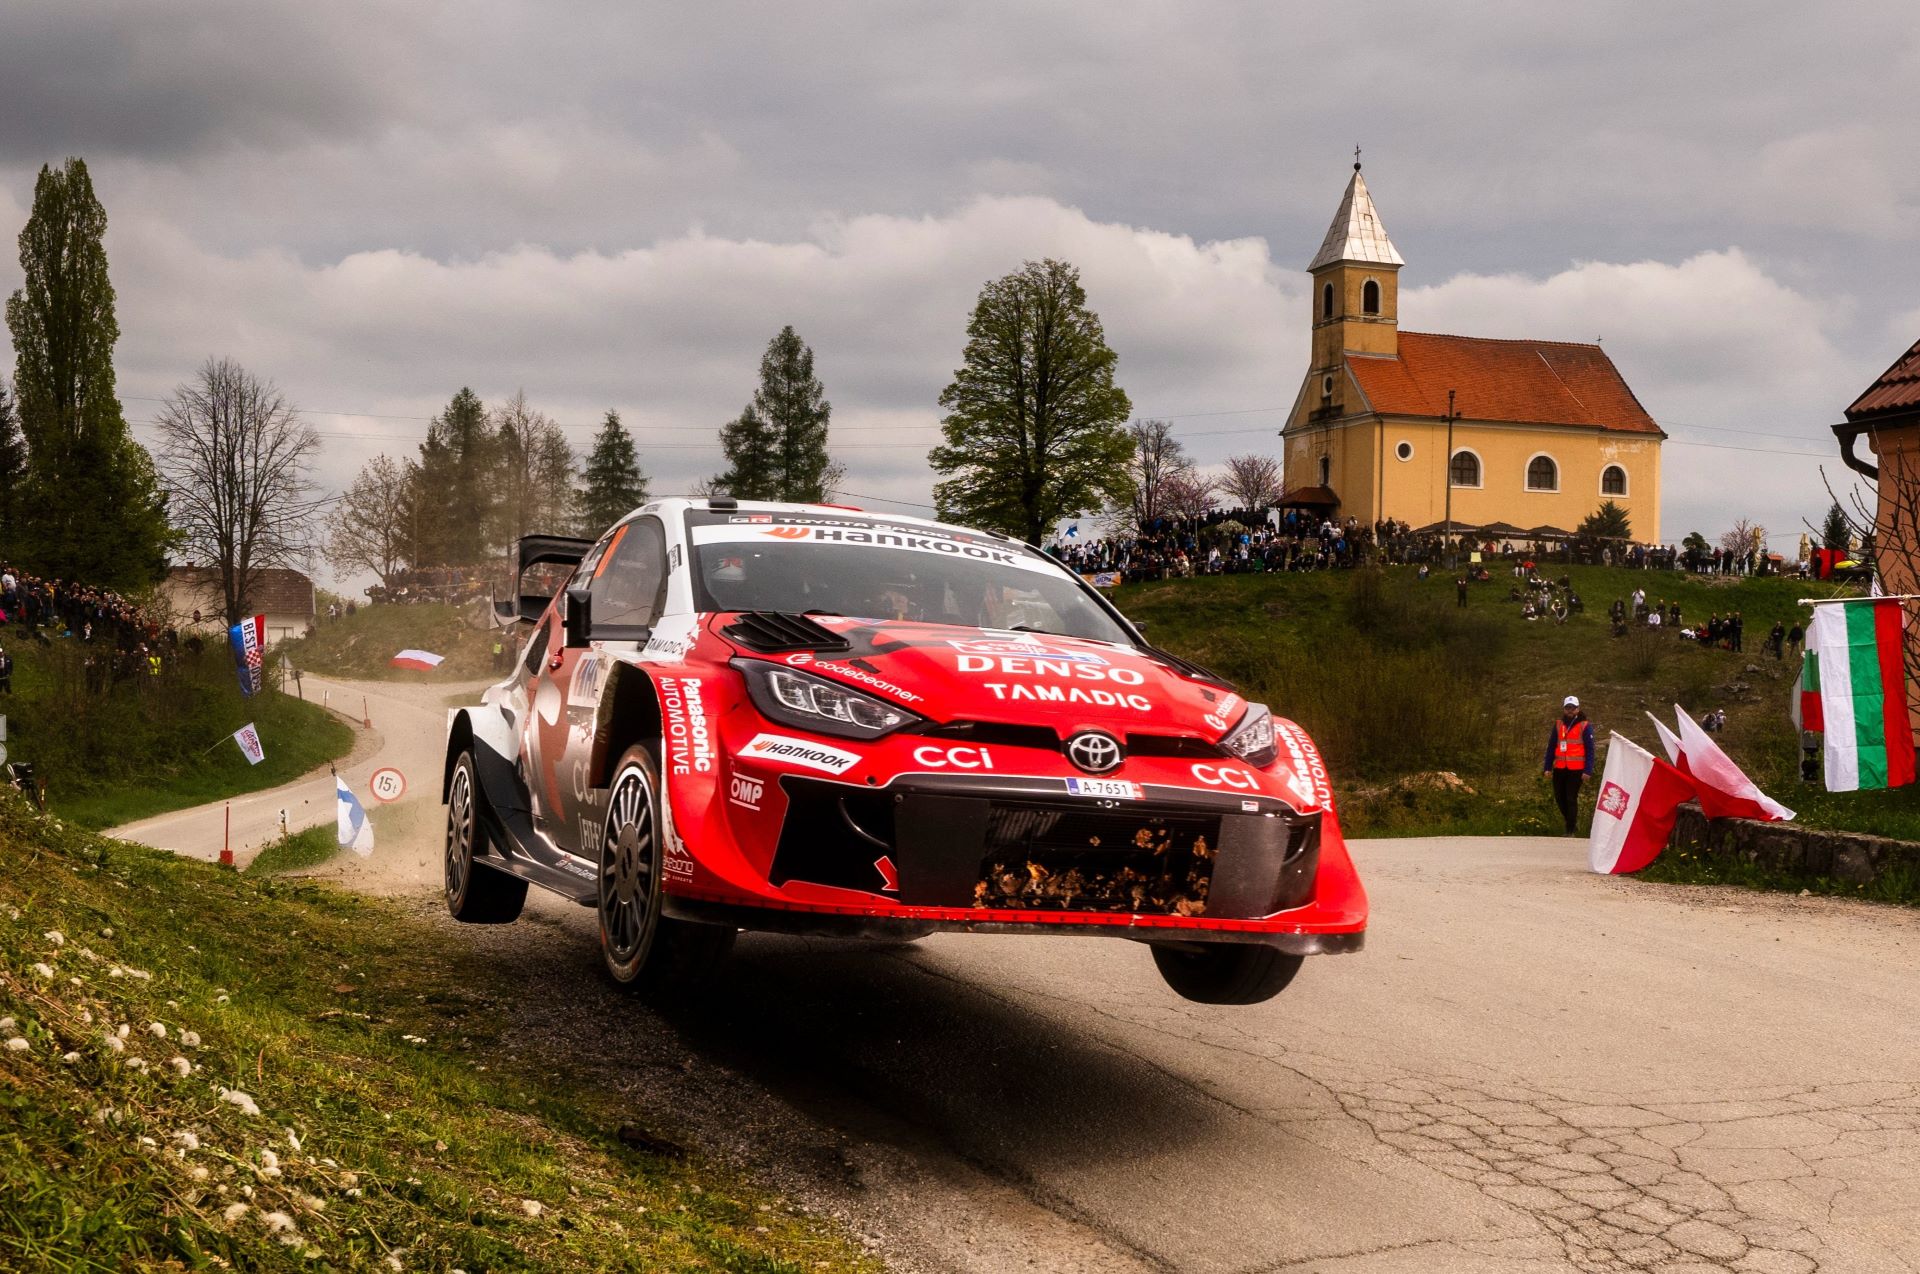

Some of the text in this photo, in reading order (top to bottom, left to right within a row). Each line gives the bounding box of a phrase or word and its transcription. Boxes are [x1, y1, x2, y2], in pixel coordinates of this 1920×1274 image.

[778, 517, 870, 529] TOYOTA
[871, 523, 951, 540] GAZOO
[243, 622, 256, 650] BEST
[647, 638, 682, 654] TAMADIC
[814, 659, 919, 703] codebeamer
[956, 654, 1145, 686] DENSO
[983, 683, 1152, 711] TAMADIC
[658, 677, 691, 776] AUTOMOTIVE
[680, 678, 716, 773] Panasonic
[1286, 724, 1333, 813] AUTOMOTIVE
[378, 775, 398, 794] 15 t
[730, 778, 764, 804] OMP
[1083, 780, 1129, 797] A-7651
